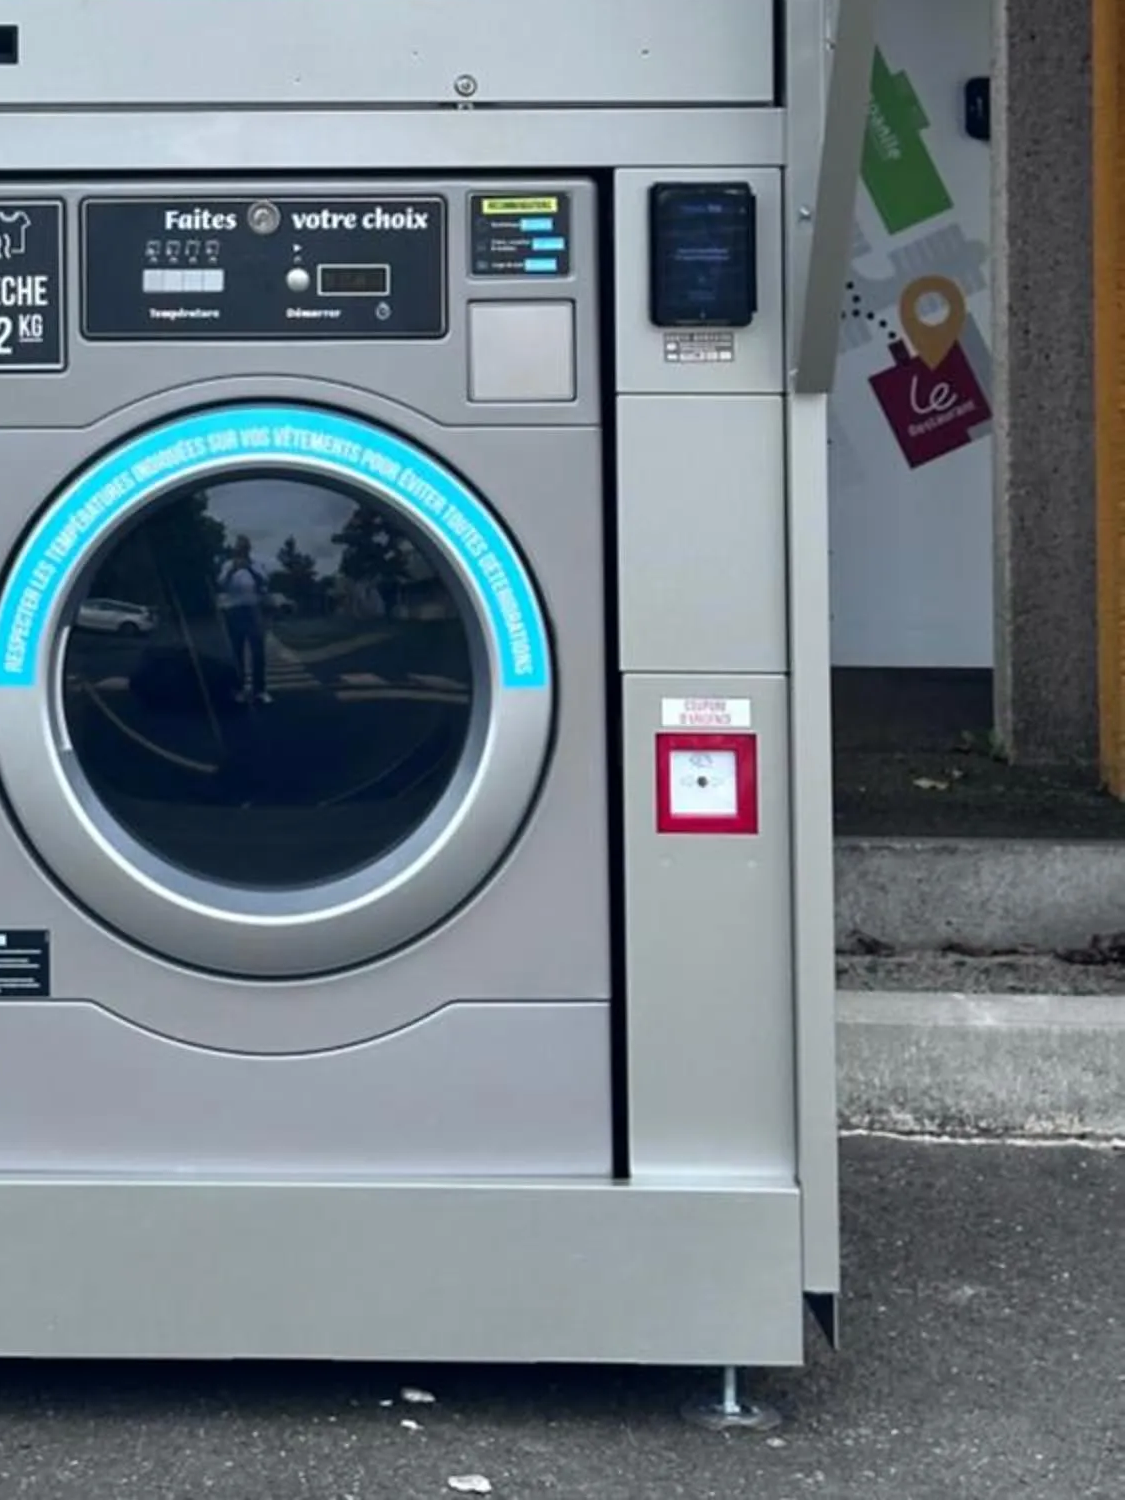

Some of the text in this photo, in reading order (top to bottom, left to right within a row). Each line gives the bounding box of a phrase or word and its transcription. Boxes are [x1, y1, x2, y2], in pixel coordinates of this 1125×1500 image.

[165, 208, 429, 232] Faites votre choix
[18, 315, 43, 341] KG
